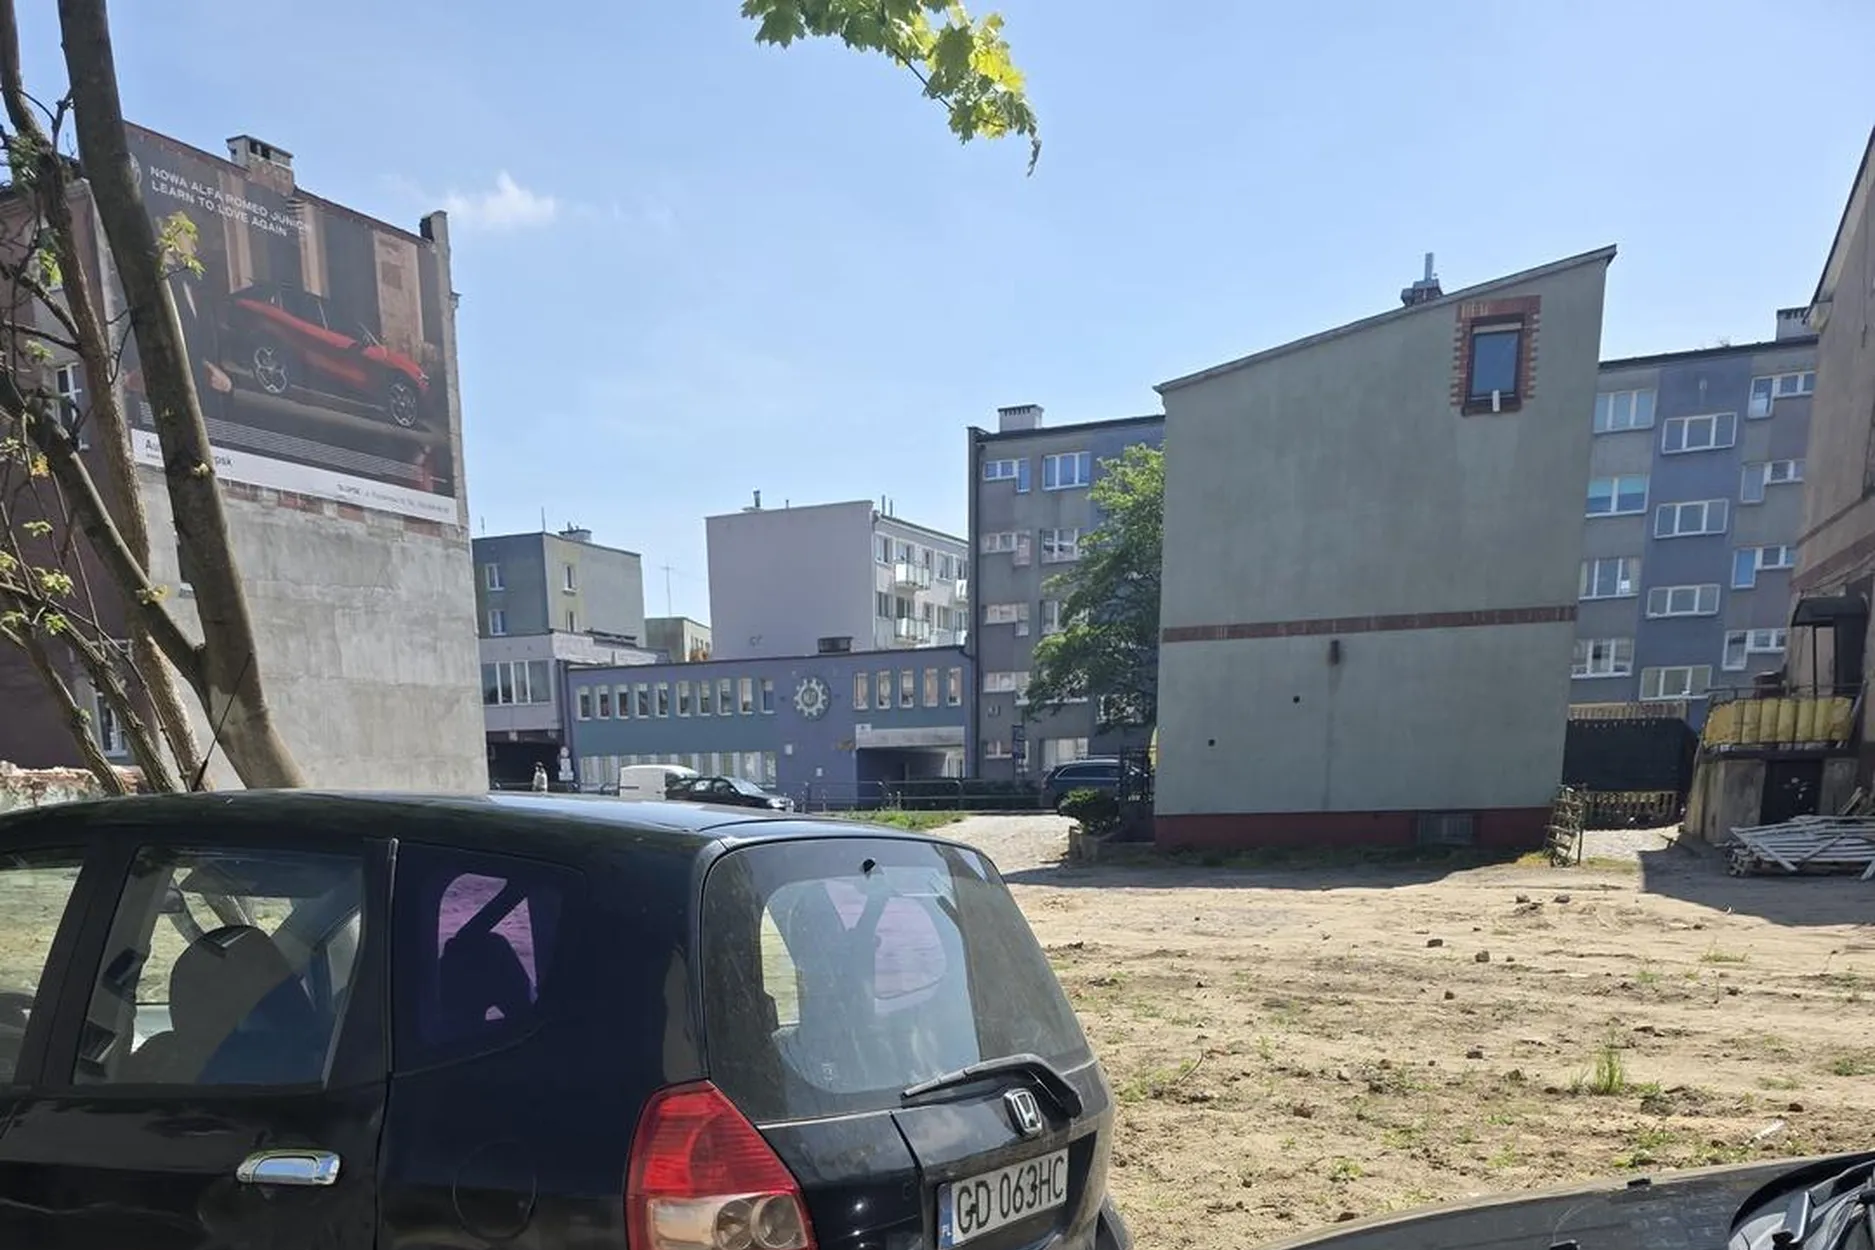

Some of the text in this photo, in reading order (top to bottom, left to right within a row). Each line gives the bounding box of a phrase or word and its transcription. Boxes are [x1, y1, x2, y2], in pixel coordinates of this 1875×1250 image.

[150, 166, 188, 189] NOWA
[191, 182, 224, 201] ALFA
[225, 194, 269, 217] ROMEO
[151, 181, 288, 237] LEARN TO LOVE AGAIN
[957, 1155, 1065, 1234] GD 063HC
